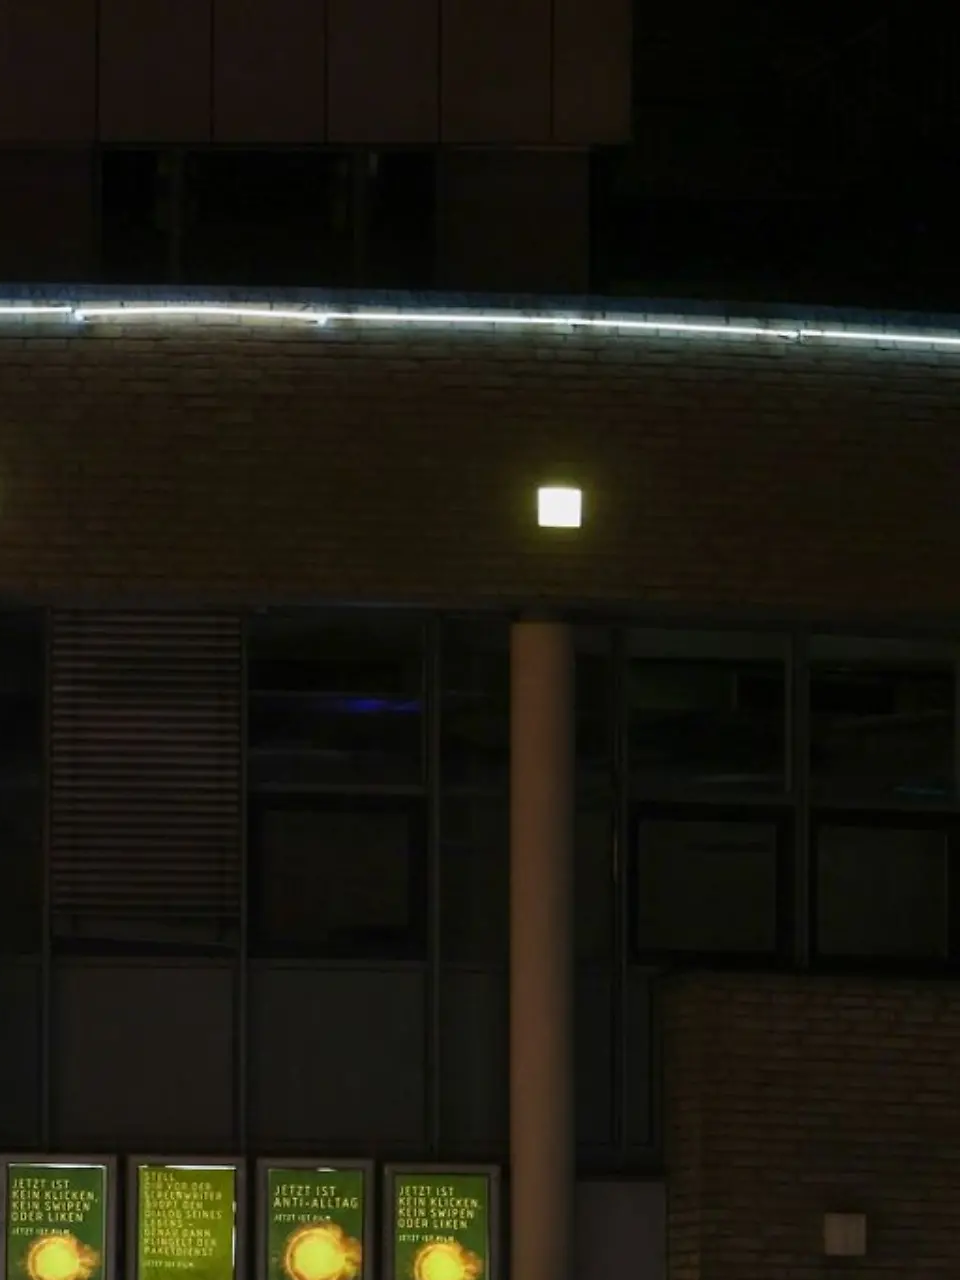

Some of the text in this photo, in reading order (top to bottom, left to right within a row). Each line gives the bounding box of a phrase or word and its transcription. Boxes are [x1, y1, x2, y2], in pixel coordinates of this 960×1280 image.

[12, 1179, 70, 1189] JETZT IST
[12, 1190, 40, 1200] KEIN
[275, 1184, 336, 1197] JETZT IST
[400, 1186, 453, 1196] JETZT IST
[12, 1201, 40, 1210] KEIN
[274, 1197, 358, 1209] ANTI-ALLTAG
[399, 1197, 426, 1207] KEIN
[12, 1211, 83, 1223] ODER LIKEN
[399, 1208, 426, 1217] KEIN
[398, 1218, 467, 1230] ODER LIKEN
